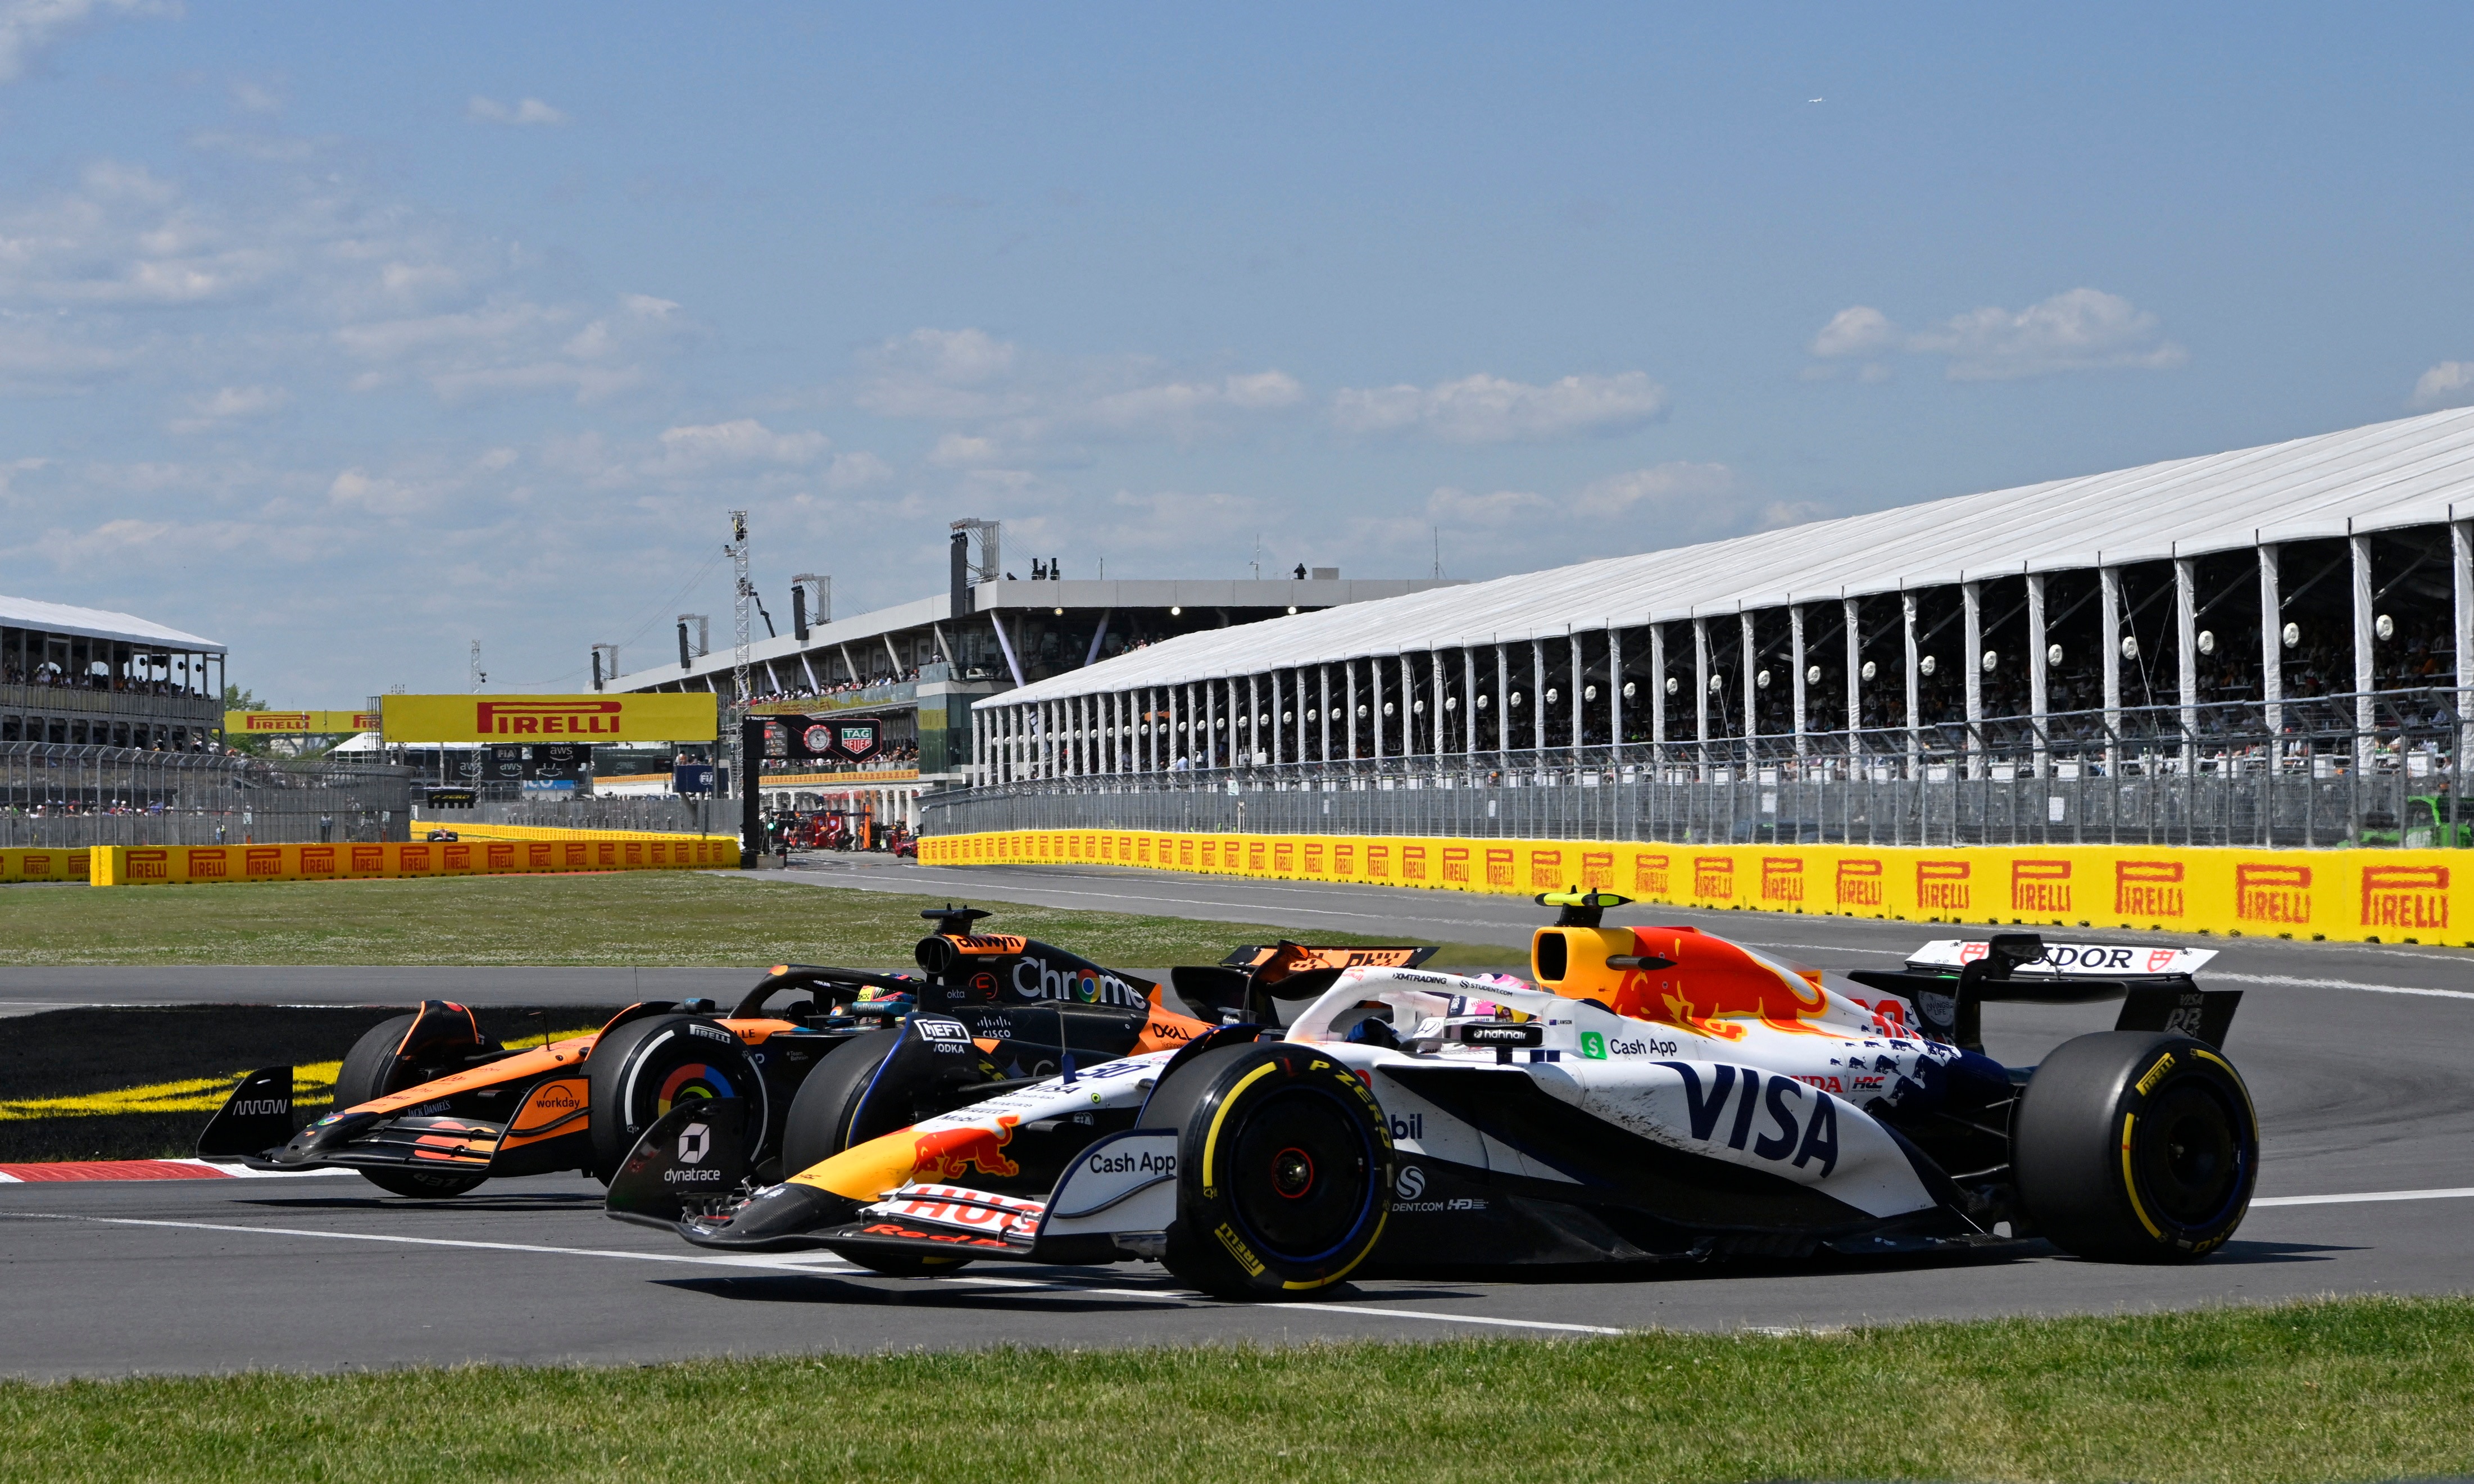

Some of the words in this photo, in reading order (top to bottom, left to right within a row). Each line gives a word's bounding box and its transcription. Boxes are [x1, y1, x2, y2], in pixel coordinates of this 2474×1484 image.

[247, 715, 310, 729] PIRELLI
[478, 701, 622, 733] PIRELLI
[550, 746, 573, 755] aws
[844, 739, 871, 751] HEUER
[24, 856, 51, 874] PIRELLI
[126, 850, 167, 878] PIRELLI
[189, 849, 226, 877] PIRELLI
[246, 848, 282, 875] PIRELLI
[299, 847, 335, 874] PIRELLI
[351, 846, 384, 872] PIRELLI
[399, 845, 431, 872] PIRELLI
[443, 845, 471, 870] PIRELLI
[487, 844, 515, 869] PIRELLI
[529, 844, 551, 867] PIRELLI
[1368, 845, 1388, 877] PIRELLI
[1403, 846, 1426, 879] PIRELLI
[1443, 847, 1469, 882] PIRELLI
[1486, 848, 1514, 886] PIRELLI
[1531, 850, 1561, 888] PIRELLI
[1582, 852, 1614, 890] PIRELLI
[1636, 854, 1669, 894] PIRELLI
[1694, 857, 1734, 899] PIRELLI
[1762, 857, 1803, 901] PIRELLI
[1836, 859, 1883, 905] PIRELLI
[1916, 861, 1971, 909] PIRELLI
[2012, 860, 2071, 911] PIRELLI
[2116, 861, 2184, 916] PIRELLI
[2236, 864, 2312, 923] PIRELLI
[2361, 865, 2449, 928] PIRELLI
[956, 935, 1022, 951] allwyn
[947, 990, 965, 999] okta
[1013, 956, 1146, 1009] Chrome
[1470, 983, 1513, 997] STUDENT.COM
[689, 1024, 730, 1043] PIRELLI
[983, 1029, 1011, 1038] CISCO
[1152, 1023, 1195, 1041] DELL
[1485, 1029, 1527, 1040] hahnair
[933, 1043, 965, 1054] VODKA
[1610, 1039, 1646, 1055] Cash
[1650, 1038, 1677, 1057] App
[2135, 1052, 2177, 1096] PIRELLI
[233, 1099, 287, 1115] ARROW
[406, 1108, 423, 1118] JACK
[536, 1097, 580, 1109] workday
[1309, 1060, 1331, 1071] P
[1334, 1070, 1392, 1149] ZERO
[1391, 1113, 1422, 1140] bil
[1649, 1061, 1839, 1179] VISA
[664, 1168, 720, 1184] dynatrace
[1090, 1152, 1135, 1173] Cash
[1140, 1151, 1177, 1175] App
[902, 1187, 1045, 1234] HUG
[1392, 1202, 1443, 1211] DENT.COM
[1215, 1222, 1266, 1277] PIRELLI
